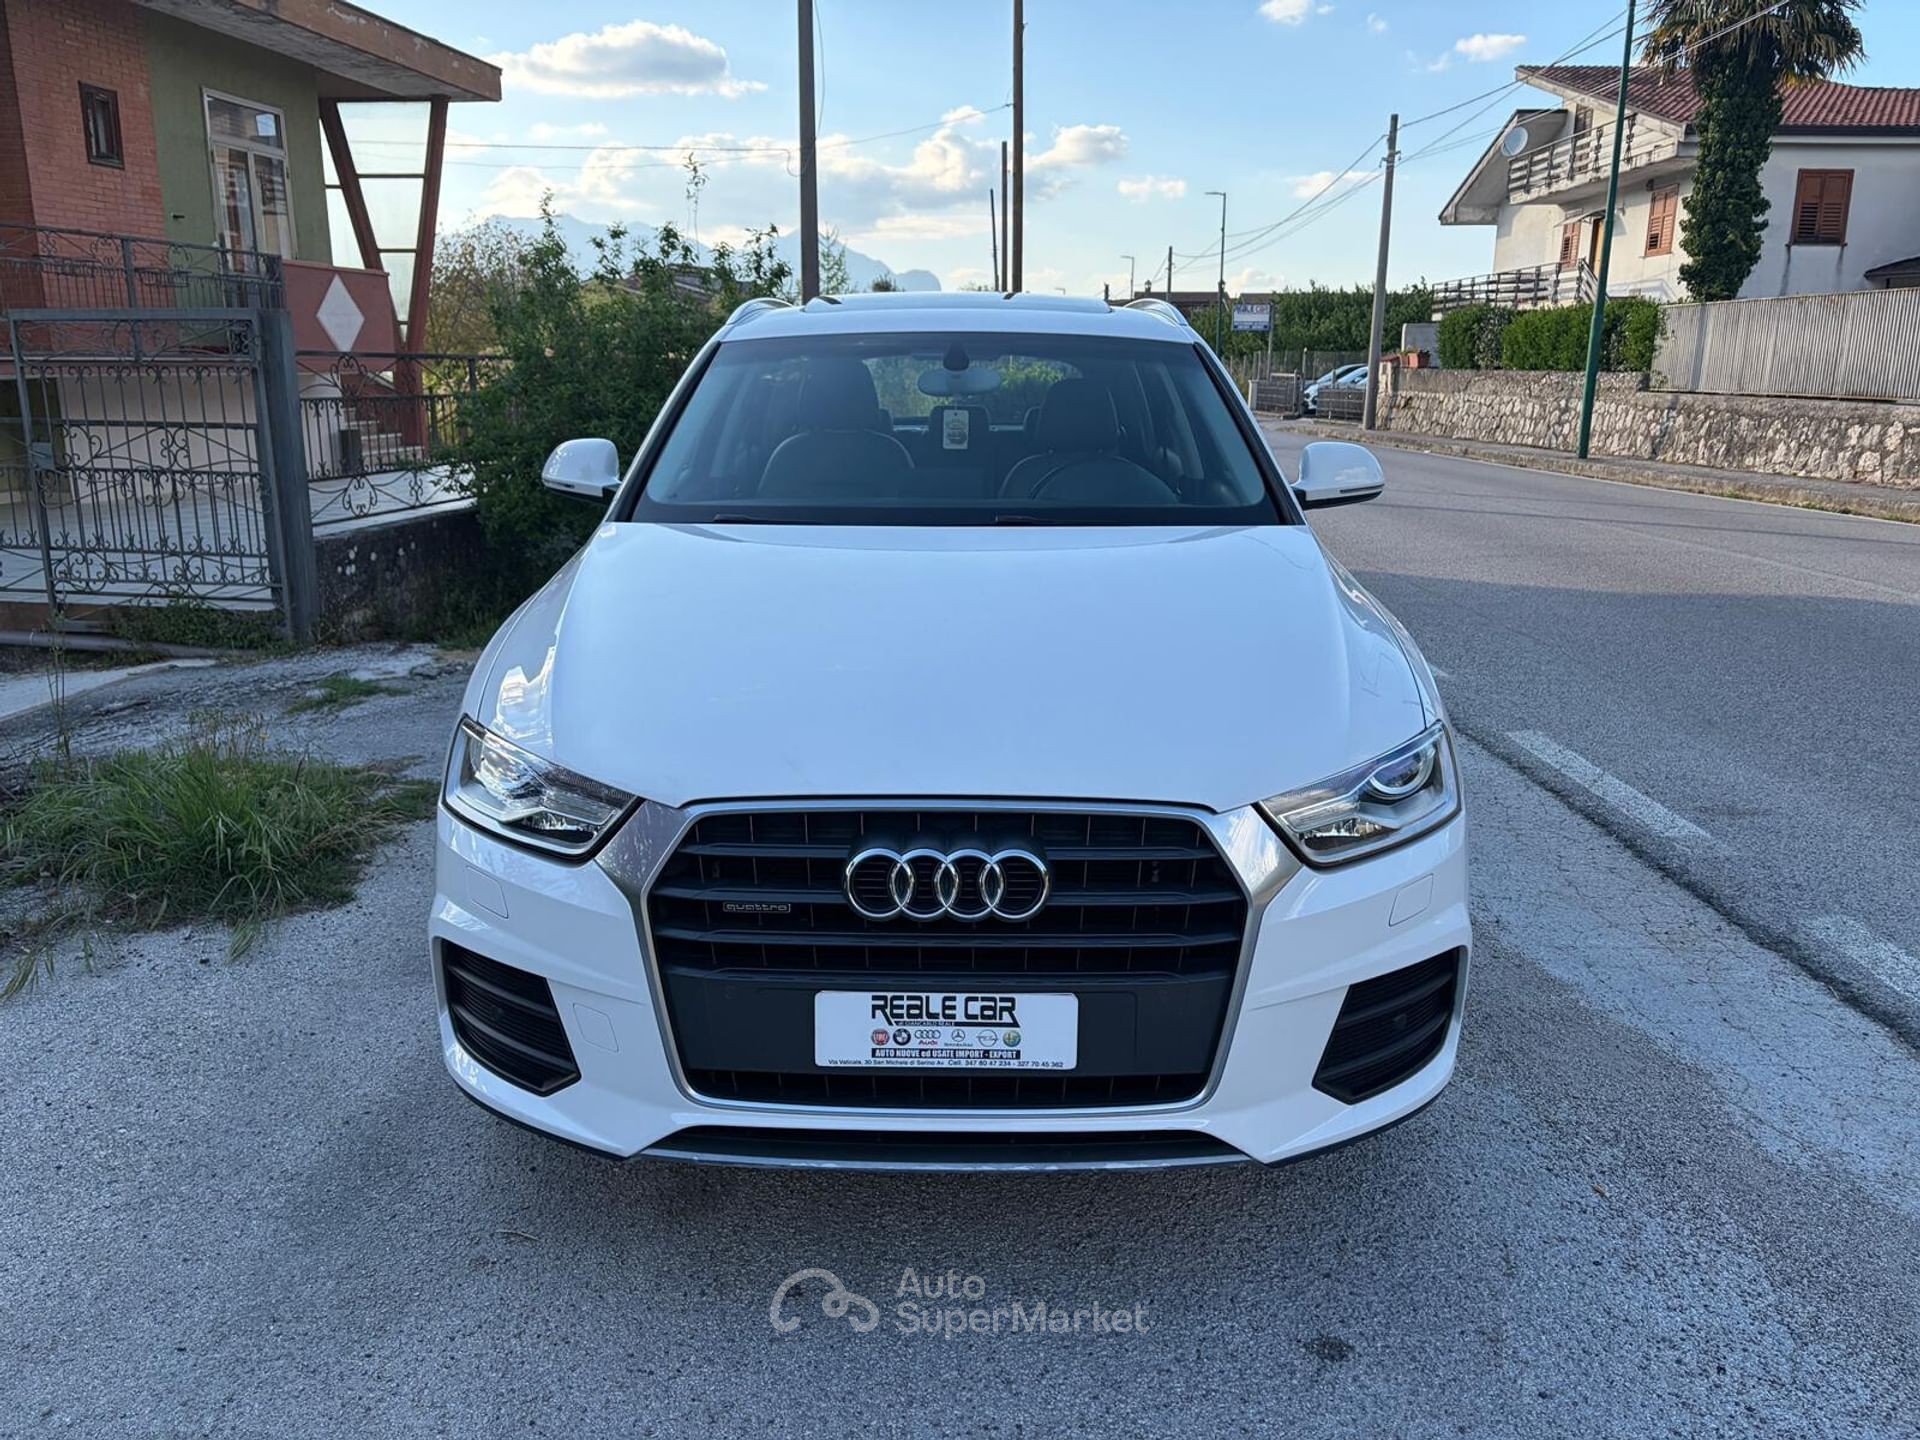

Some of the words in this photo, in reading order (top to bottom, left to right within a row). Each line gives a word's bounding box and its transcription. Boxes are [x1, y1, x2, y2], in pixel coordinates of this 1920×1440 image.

[725, 903, 788, 912] quattro
[875, 1049, 895, 1057] AUTO
[896, 1049, 920, 1057] NUOVE
[920, 1049, 931, 1057] ed
[932, 1050, 955, 1058] USATE
[955, 1050, 984, 1058] IMPORT
[988, 1050, 1017, 1058] EXPORT
